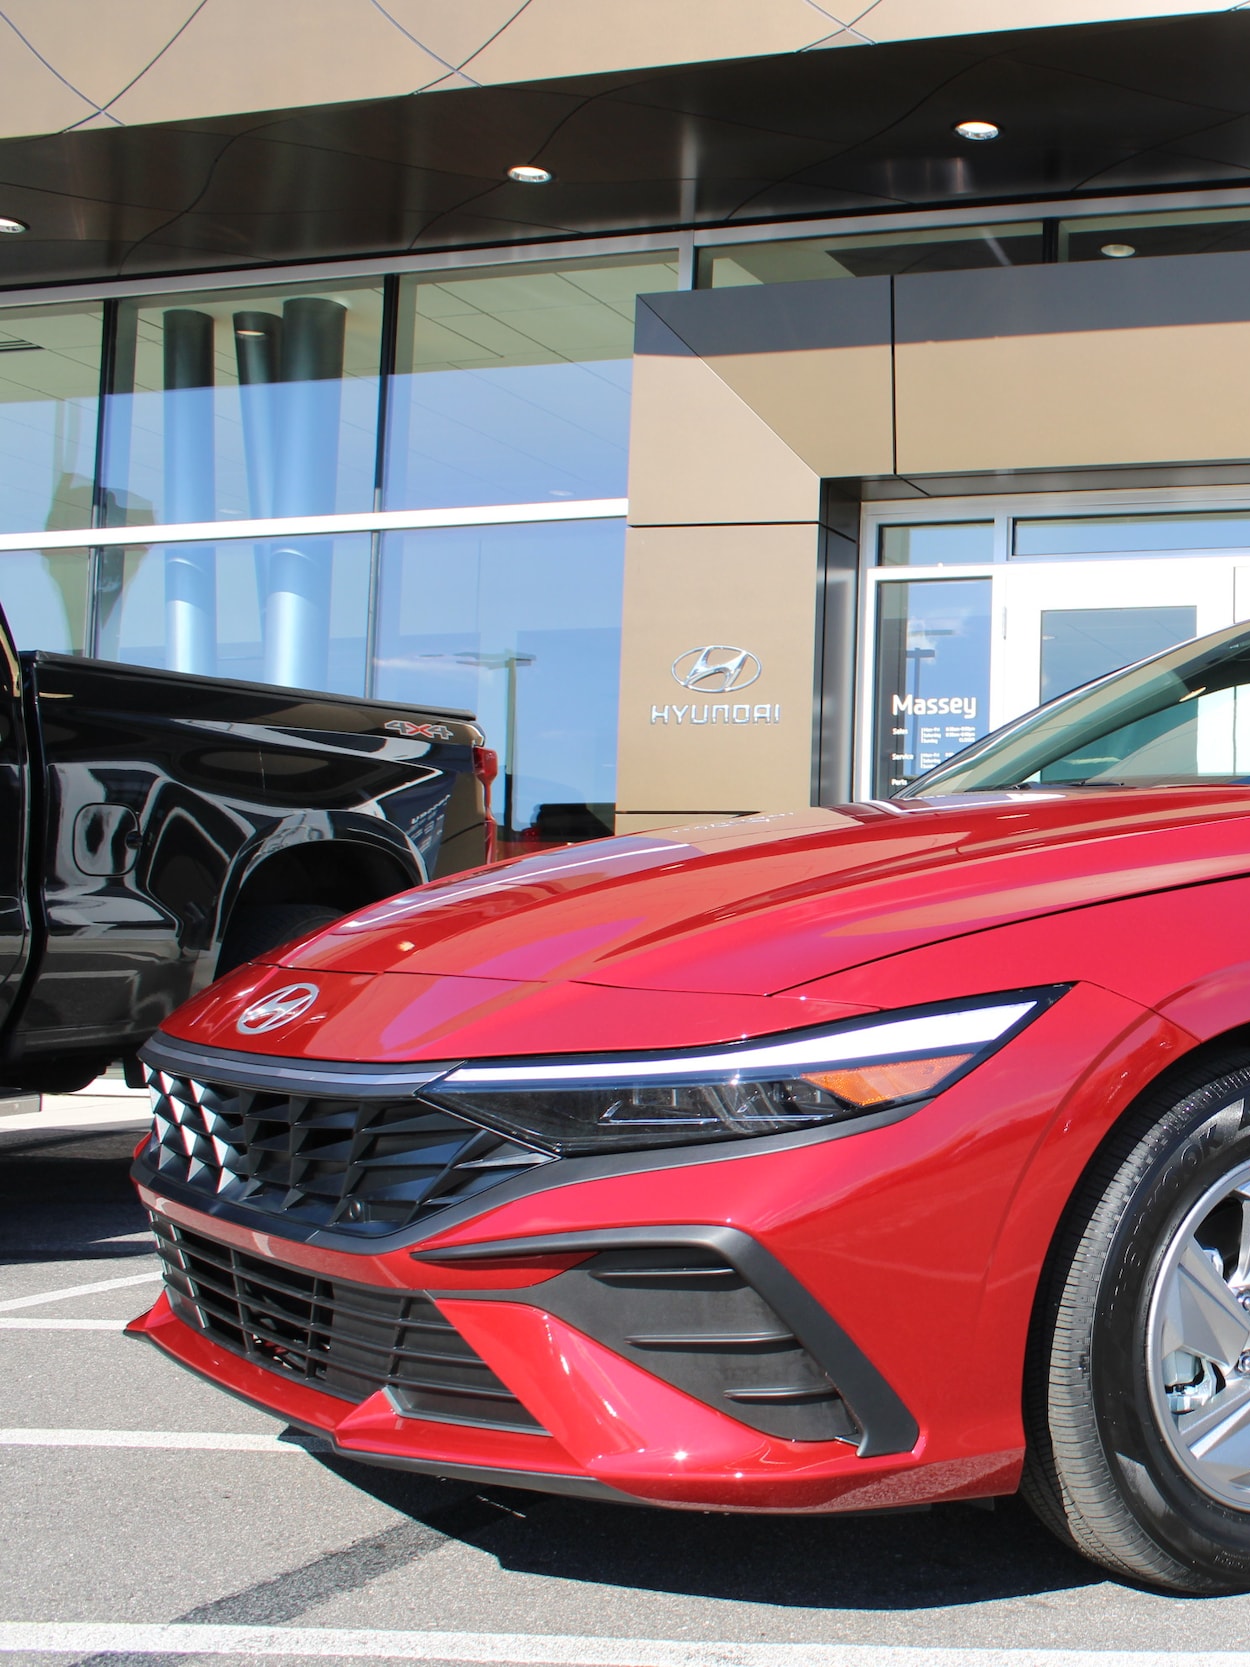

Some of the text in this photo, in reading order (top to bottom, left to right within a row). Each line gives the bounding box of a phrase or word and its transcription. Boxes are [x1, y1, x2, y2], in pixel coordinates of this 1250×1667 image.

[650, 703, 781, 725] HYUNDAI
[892, 694, 977, 719] Massey
[892, 753, 915, 761] Service
